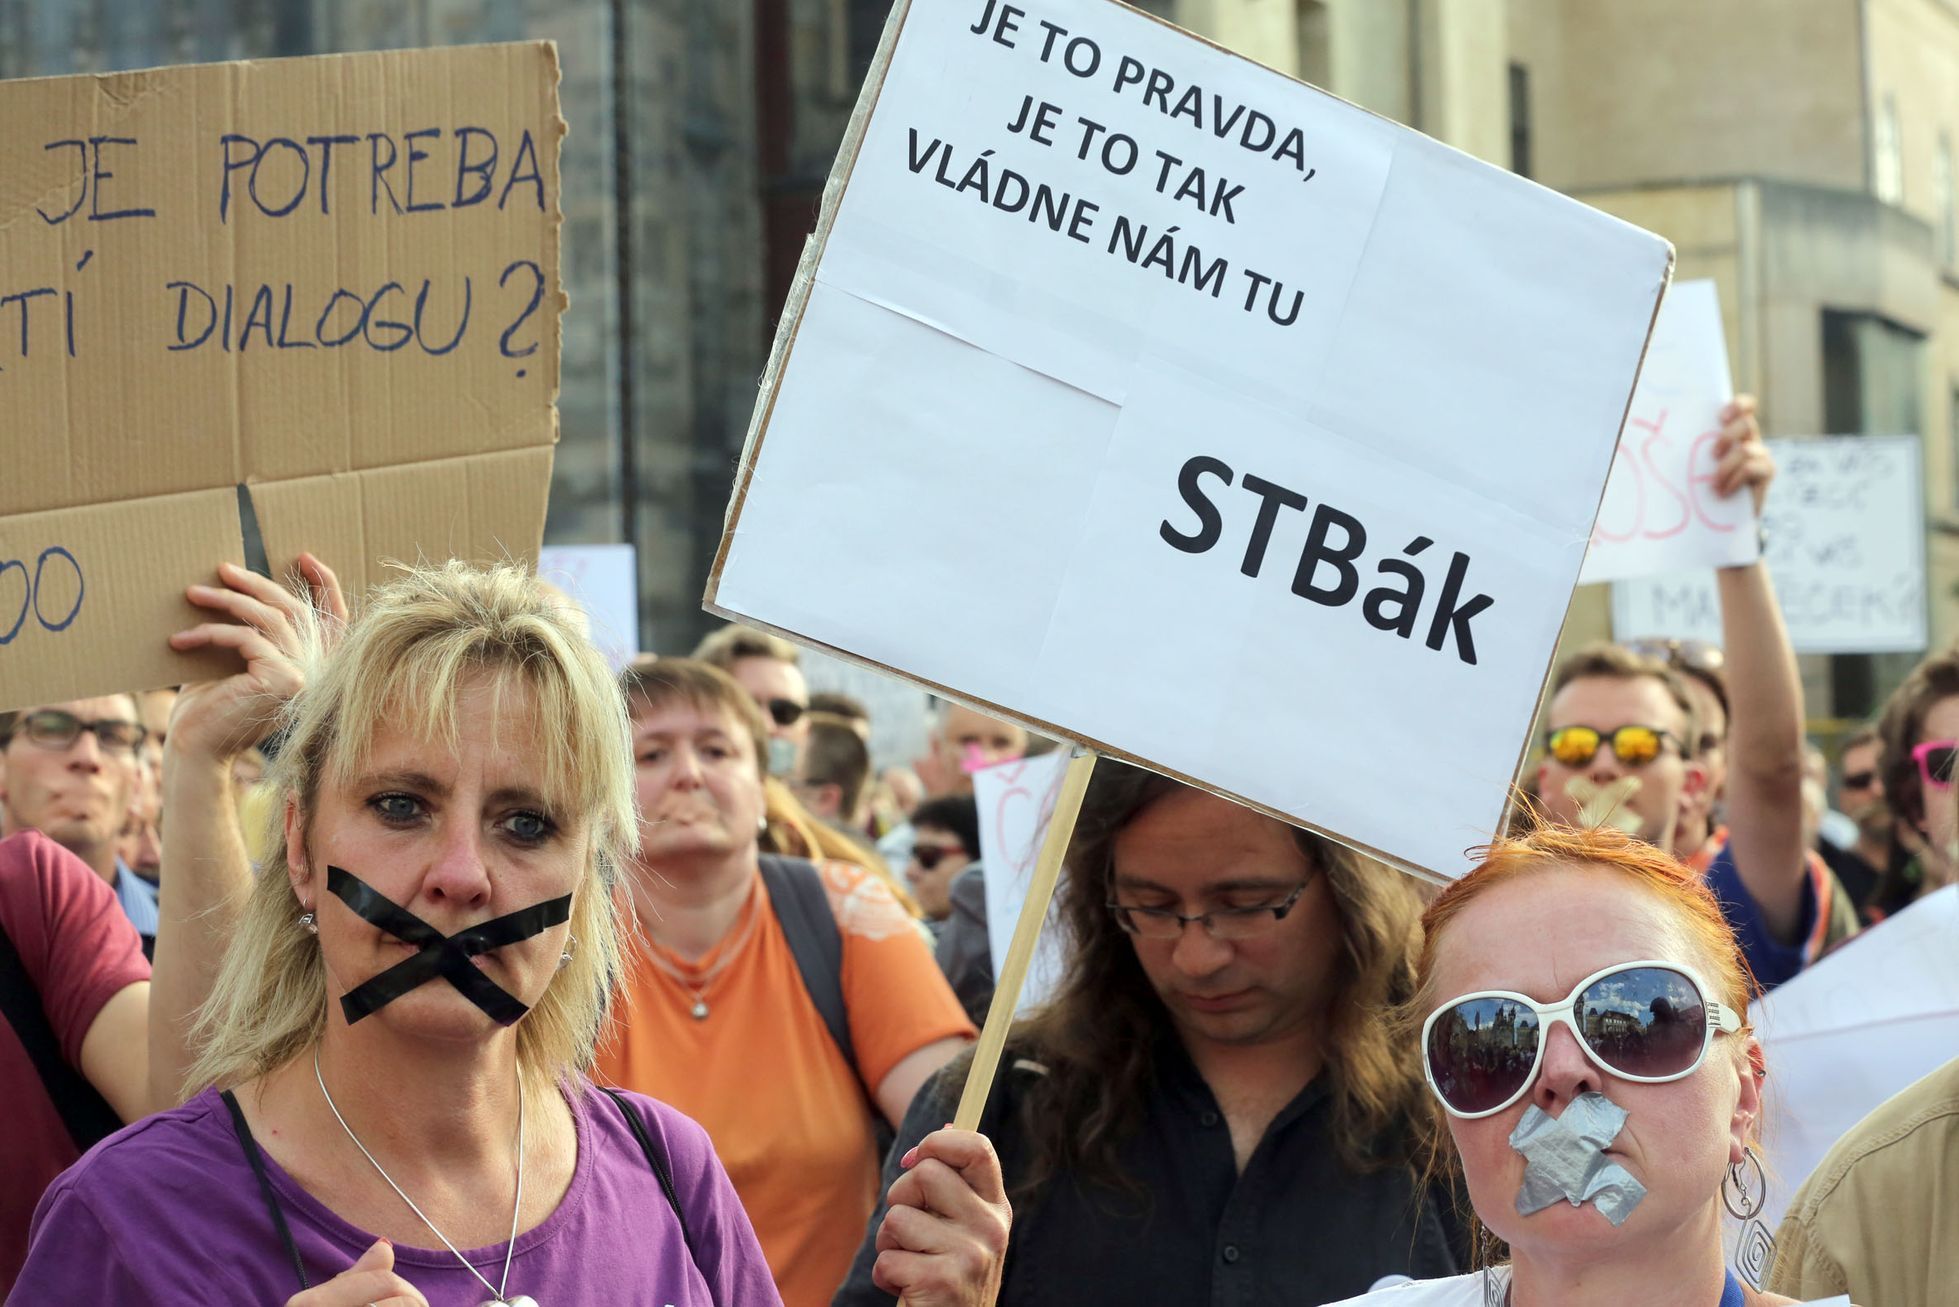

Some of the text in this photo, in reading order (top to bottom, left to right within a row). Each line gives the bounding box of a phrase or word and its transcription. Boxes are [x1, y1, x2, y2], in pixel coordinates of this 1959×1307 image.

[970, 0, 1316, 182] JE TO PRAVDA,
[1007, 95, 1246, 225] JE TO TAK
[37, 127, 545, 224] JE POTREBA
[908, 127, 1305, 327] VLÁDNE NÁM TU
[0, 249, 94, 372] TÍ
[167, 276, 471, 355] DIALOGU
[1159, 455, 1495, 666] STBák
